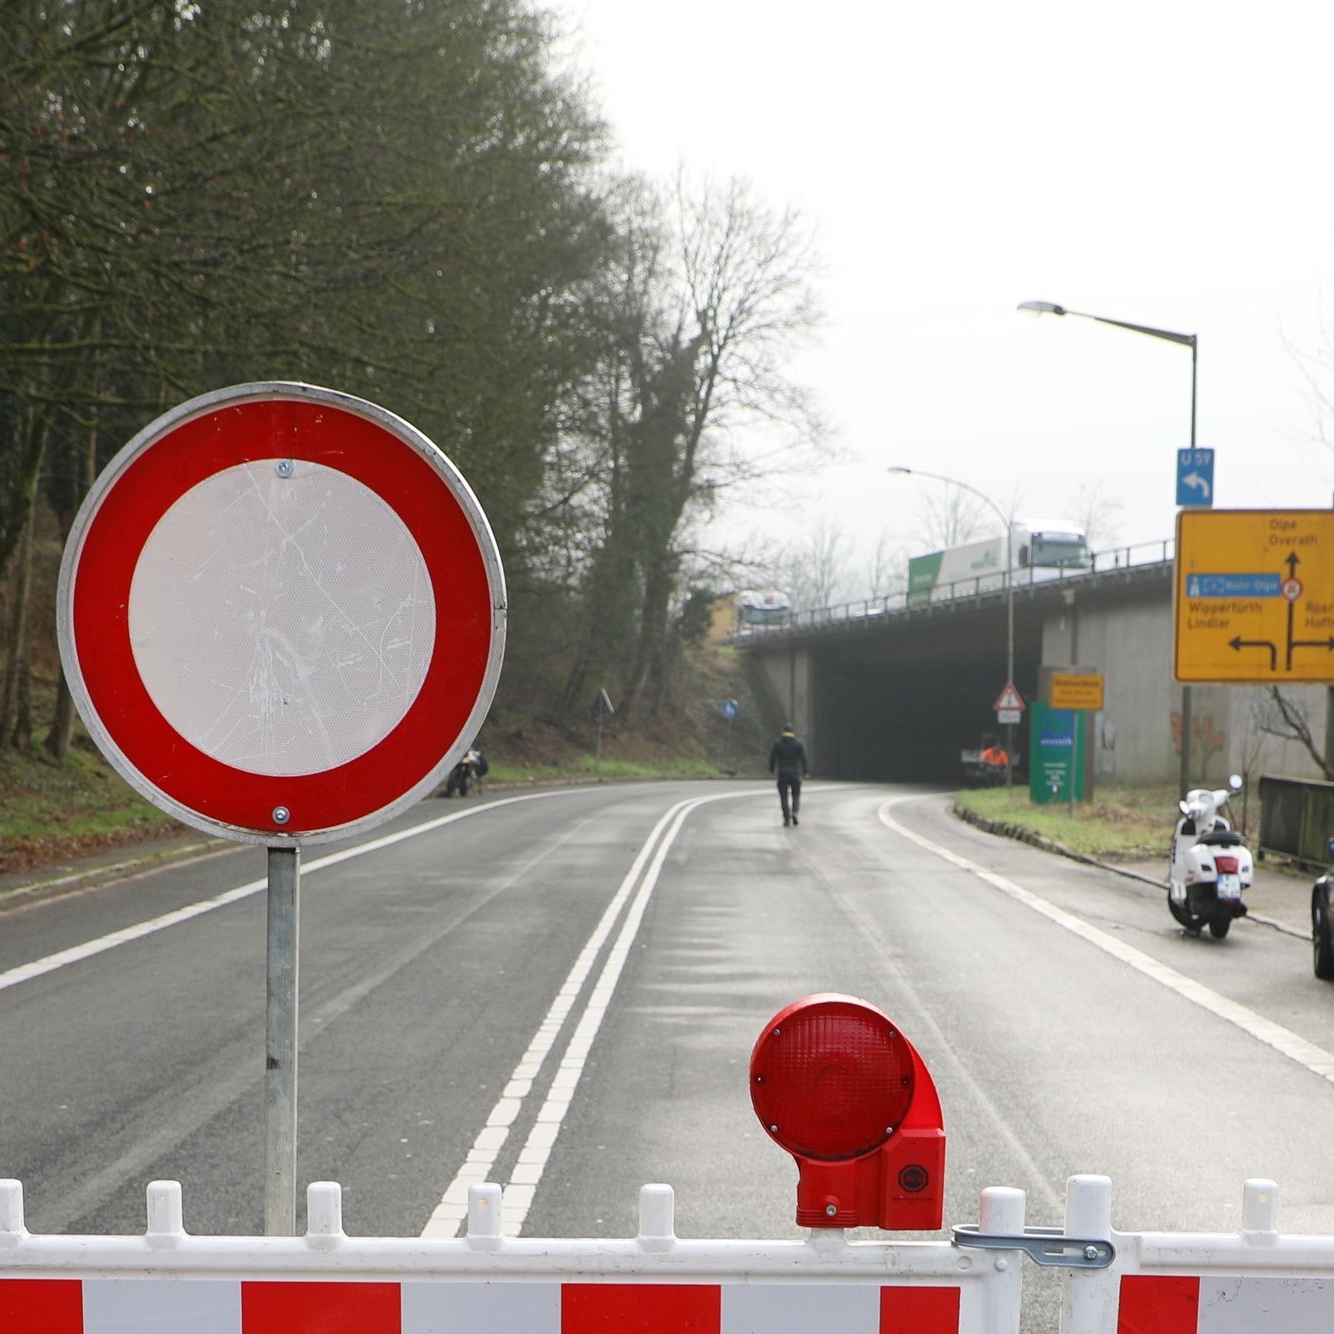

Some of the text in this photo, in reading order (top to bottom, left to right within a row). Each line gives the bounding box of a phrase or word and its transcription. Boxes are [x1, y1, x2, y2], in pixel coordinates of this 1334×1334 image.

[1180, 451, 1192, 466] U
[1270, 519, 1296, 531] Olpe
[1269, 534, 1318, 546] Overath
[1188, 601, 1263, 614] Wipperfürth
[1187, 617, 1230, 629] Lindlar
